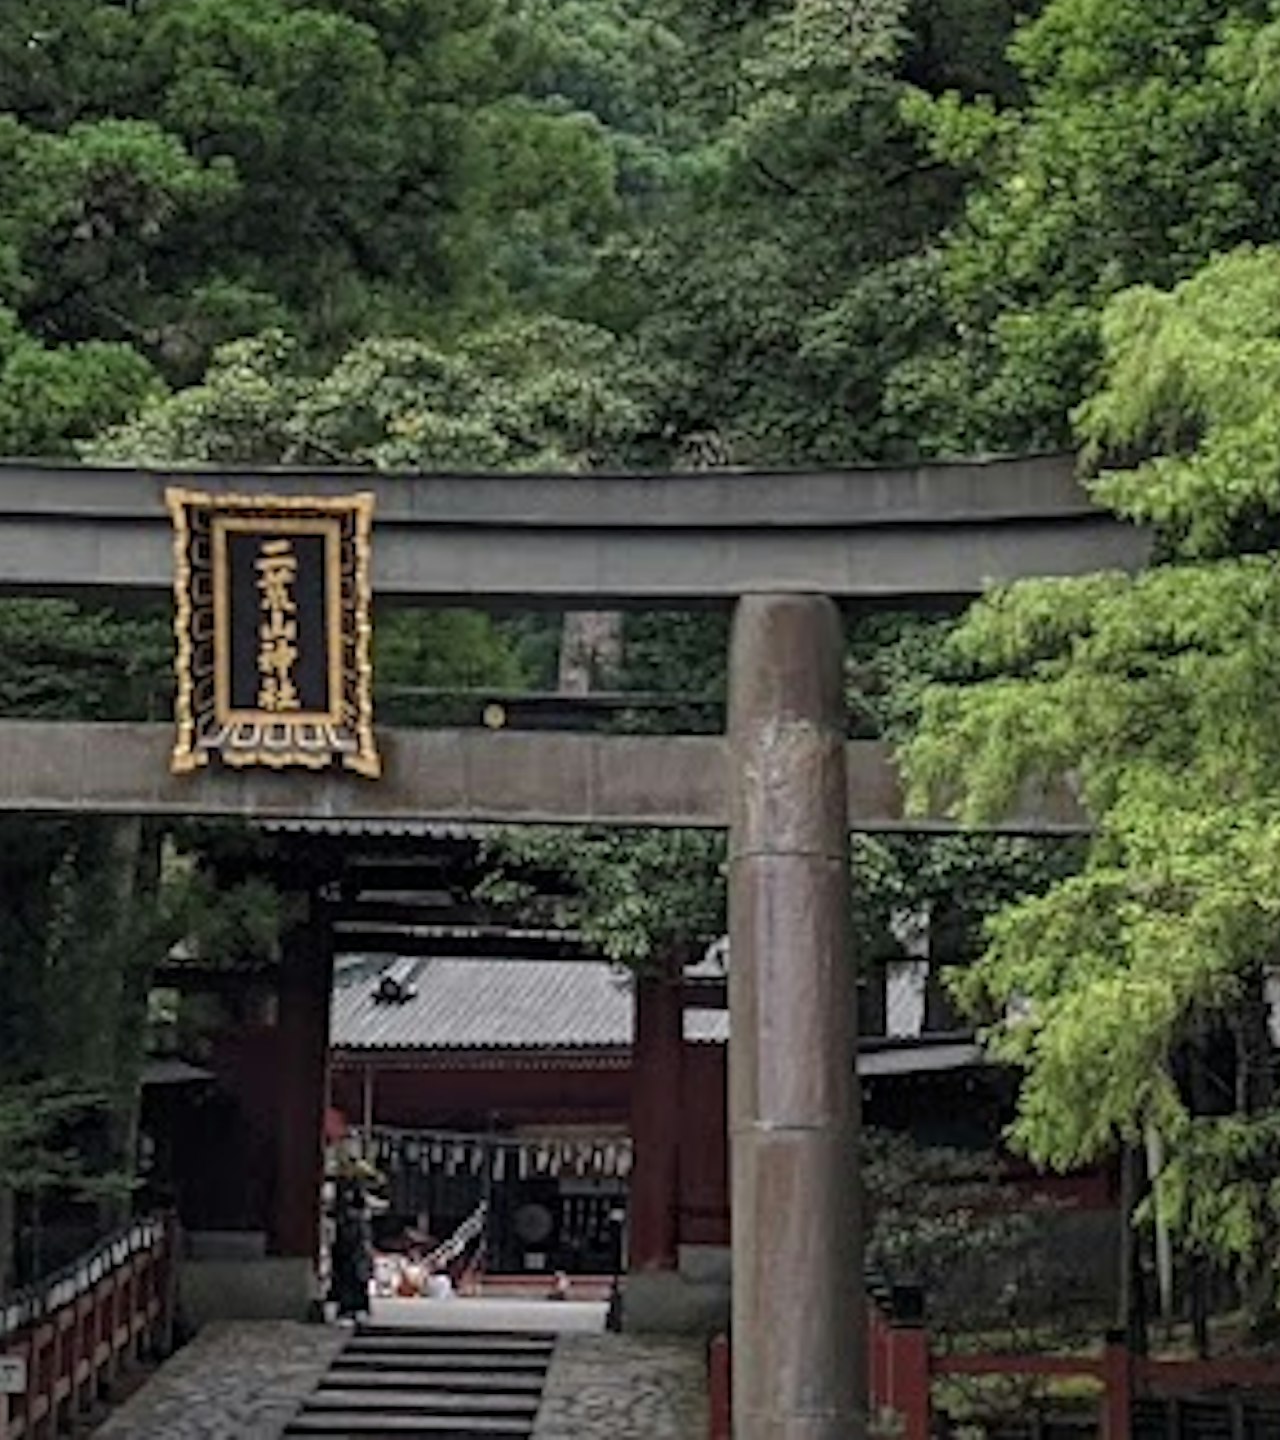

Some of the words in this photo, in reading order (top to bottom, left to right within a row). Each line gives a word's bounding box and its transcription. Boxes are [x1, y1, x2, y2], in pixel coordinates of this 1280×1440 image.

[253, 538, 300, 710] 二荒山神社
